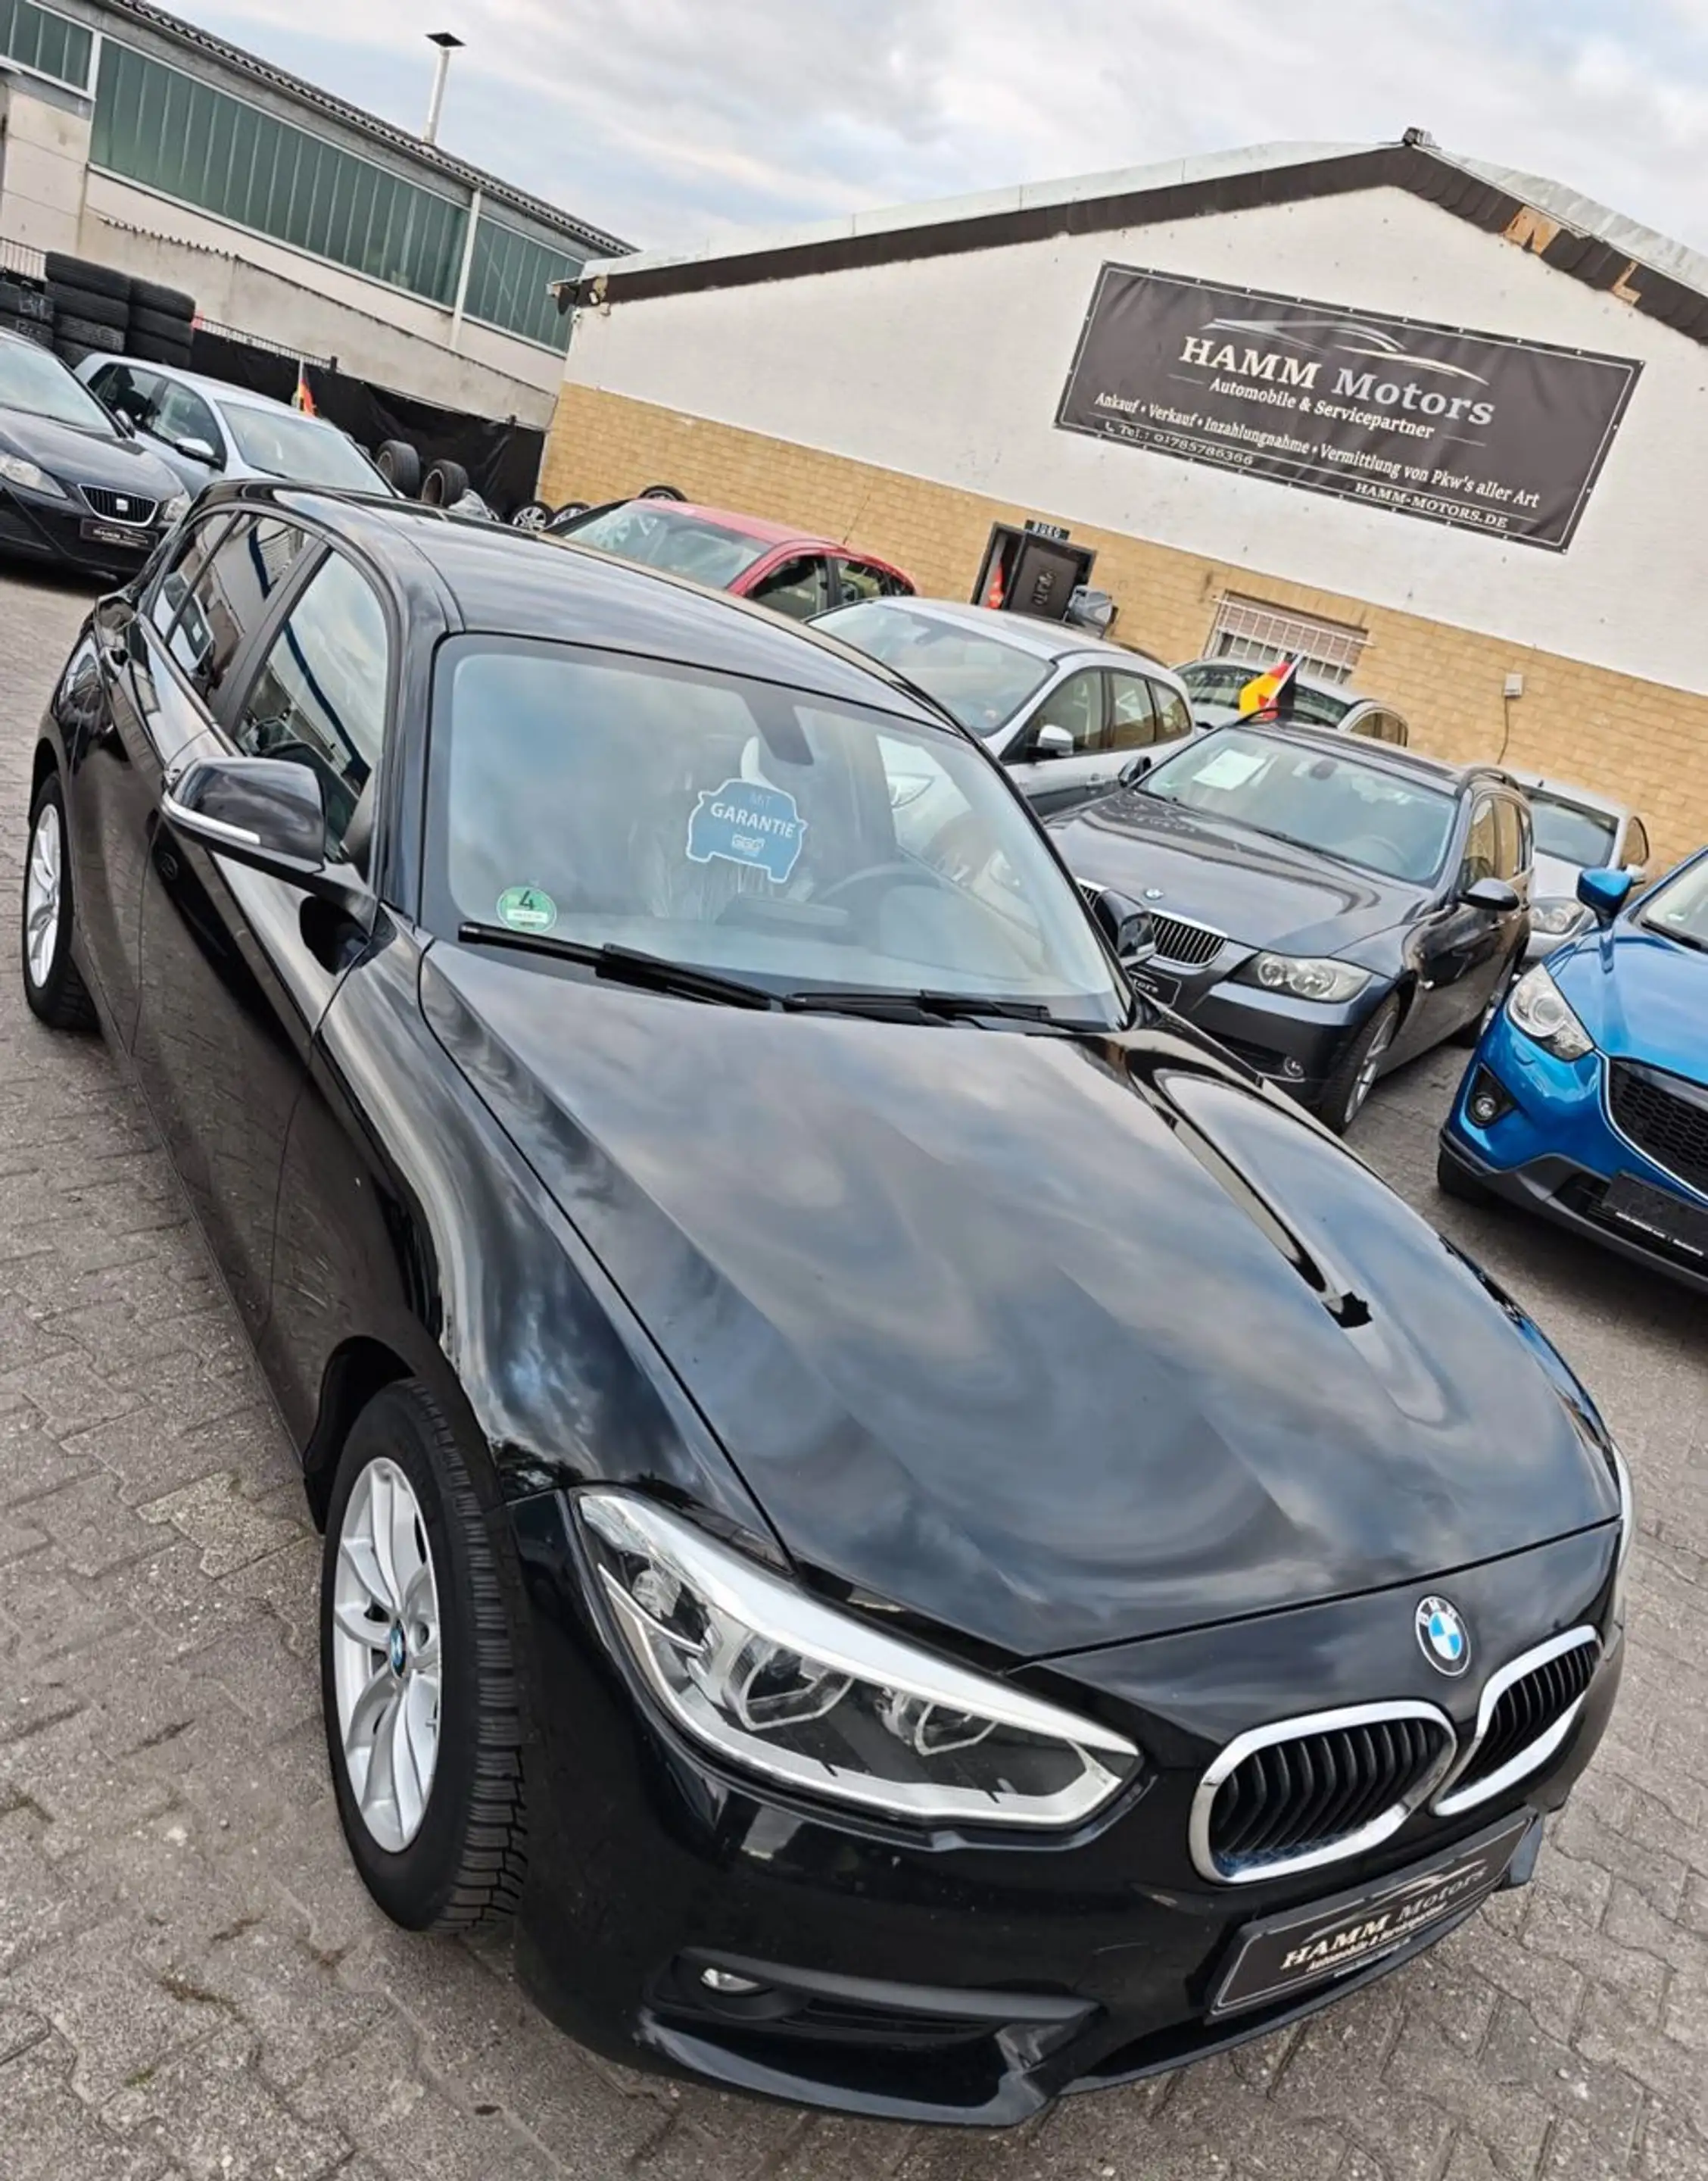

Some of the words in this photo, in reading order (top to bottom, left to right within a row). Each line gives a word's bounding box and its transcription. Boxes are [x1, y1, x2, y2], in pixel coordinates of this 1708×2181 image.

[1179, 335, 1322, 389] HAMM
[1331, 367, 1495, 425] Motors
[1209, 377, 1297, 409] Automobile
[1298, 396, 1312, 413] &
[1314, 400, 1435, 439] Servicepartner
[1095, 392, 1139, 413] Ankauf
[1149, 404, 1196, 427] Verkauf
[1204, 417, 1310, 454] Inzahlungnahme
[1320, 444, 1402, 479] Vermittlung
[1404, 466, 1429, 481] von
[1430, 470, 1475, 493] Pkw's
[1476, 480, 1513, 501] aller
[1513, 489, 1541, 509] Art
[1354, 482, 1509, 529] HAMM-MOTORS.DE
[710, 802, 796, 838] GARANTIE
[519, 890, 535, 910] 4
[1280, 1914, 1392, 1970] HAMM
[1396, 1865, 1489, 1924] Motors
